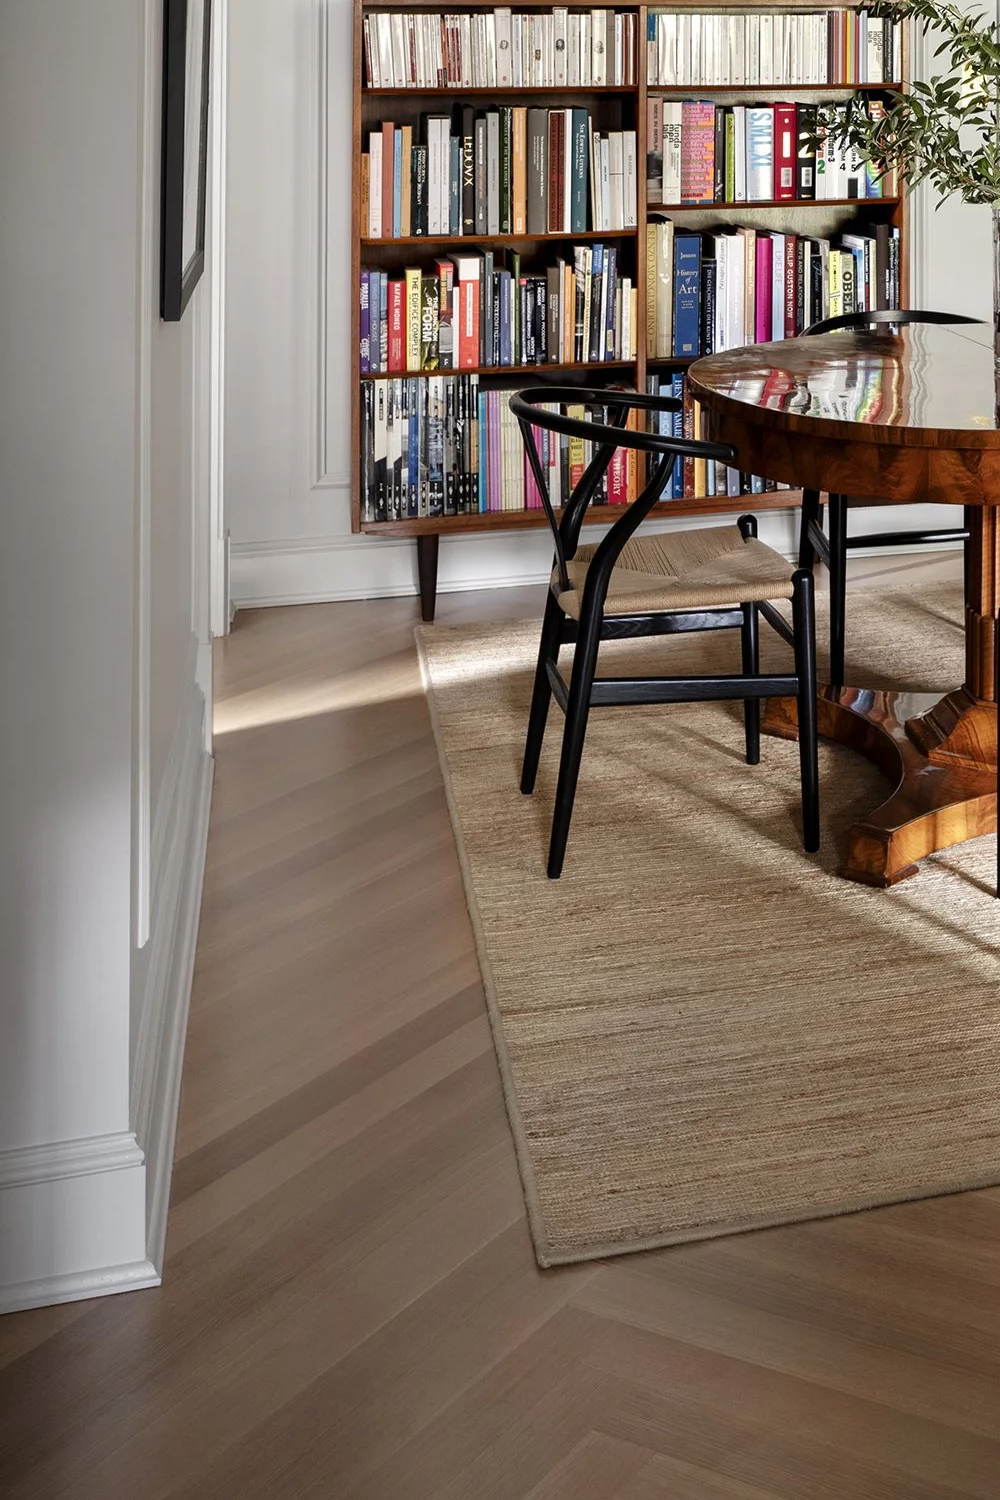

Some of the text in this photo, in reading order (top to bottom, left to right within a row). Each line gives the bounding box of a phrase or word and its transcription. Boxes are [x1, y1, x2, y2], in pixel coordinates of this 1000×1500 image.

[674, 124, 682, 149] funda
[817, 159, 826, 174] 2
[840, 162, 846, 171] 4
[647, 230, 655, 259] RENZO
[680, 252, 697, 260] Janson
[676, 270, 699, 278] History
[678, 284, 697, 295] Art
[422, 307, 432, 342] FORM
